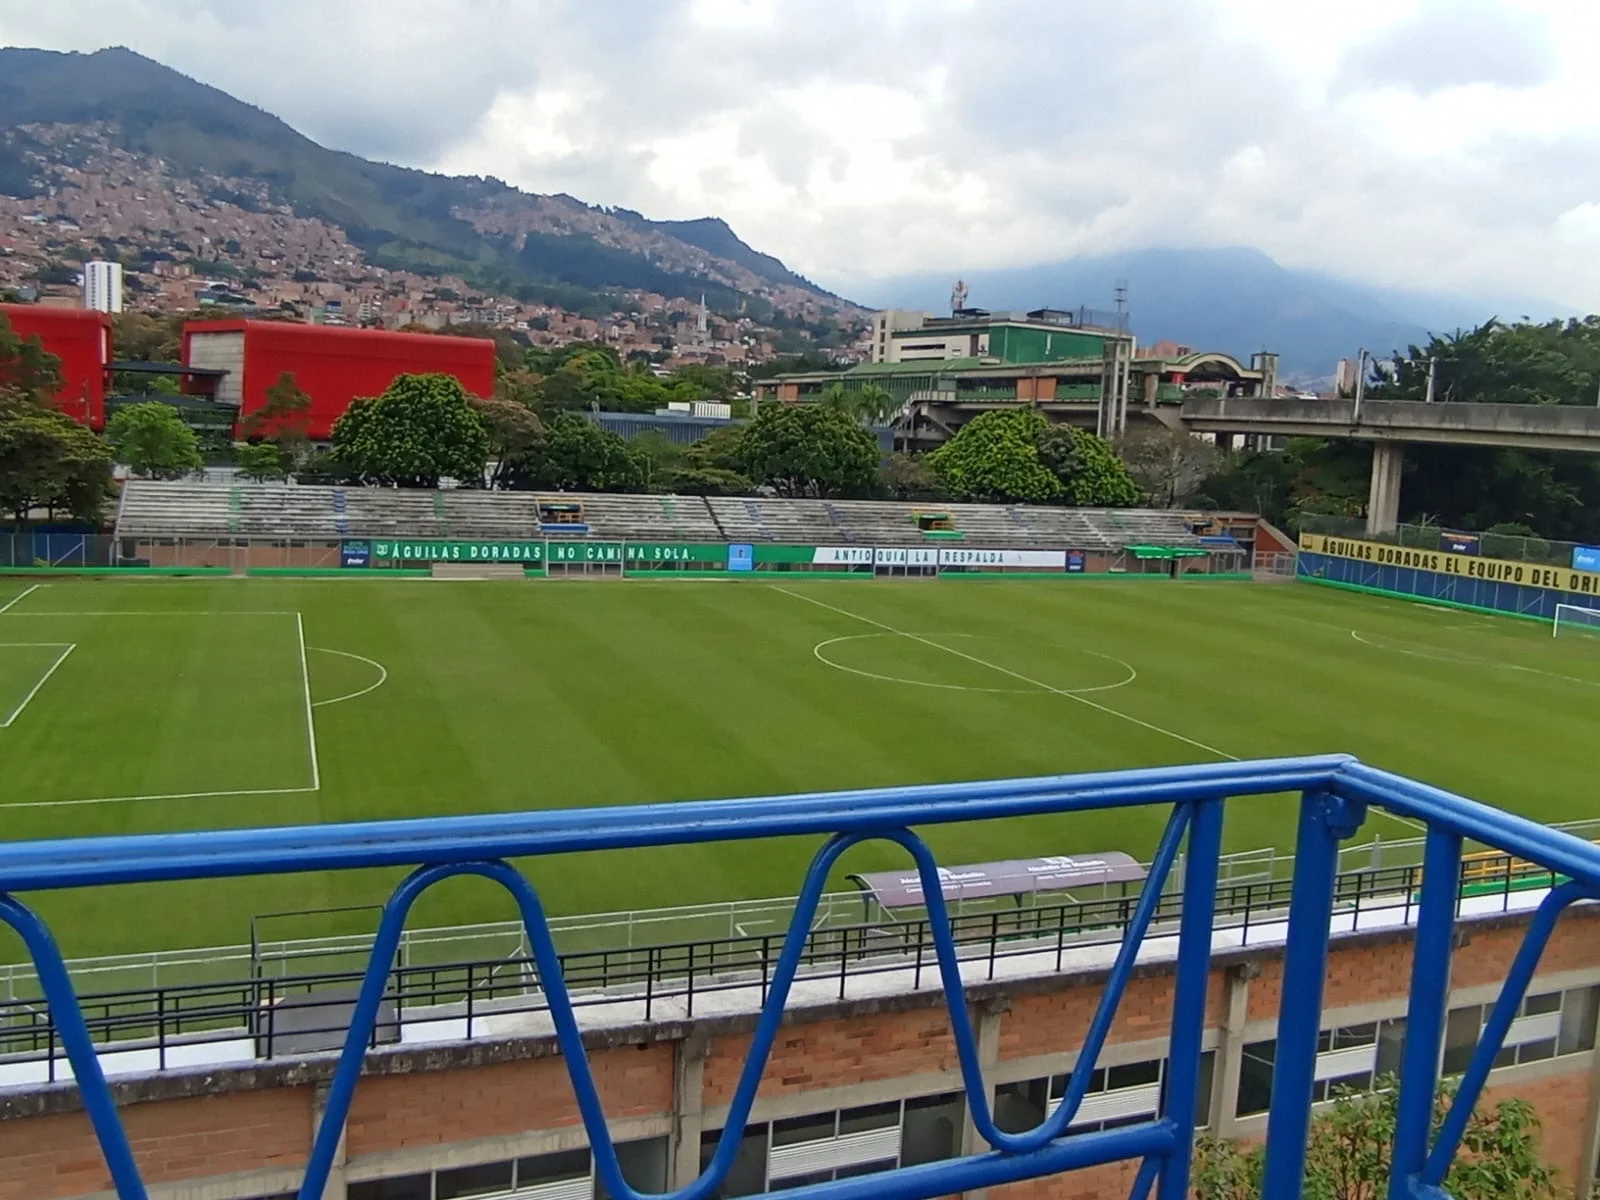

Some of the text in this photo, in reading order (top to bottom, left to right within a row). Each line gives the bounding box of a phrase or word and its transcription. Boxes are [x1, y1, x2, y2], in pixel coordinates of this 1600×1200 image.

[392, 543, 460, 559] ÁGUILAS
[470, 546, 541, 559] DORADAS
[557, 546, 575, 559] NO
[654, 547, 695, 560] SOLA.
[915, 550, 929, 562] LA
[945, 550, 1004, 563] RESPALDA
[1322, 537, 1372, 560] ÁGUILAS
[1378, 548, 1438, 570] DORADAS
[1446, 557, 1460, 573] EL
[1468, 560, 1523, 582] EQUIPO
[1531, 569, 1559, 587] DEL
